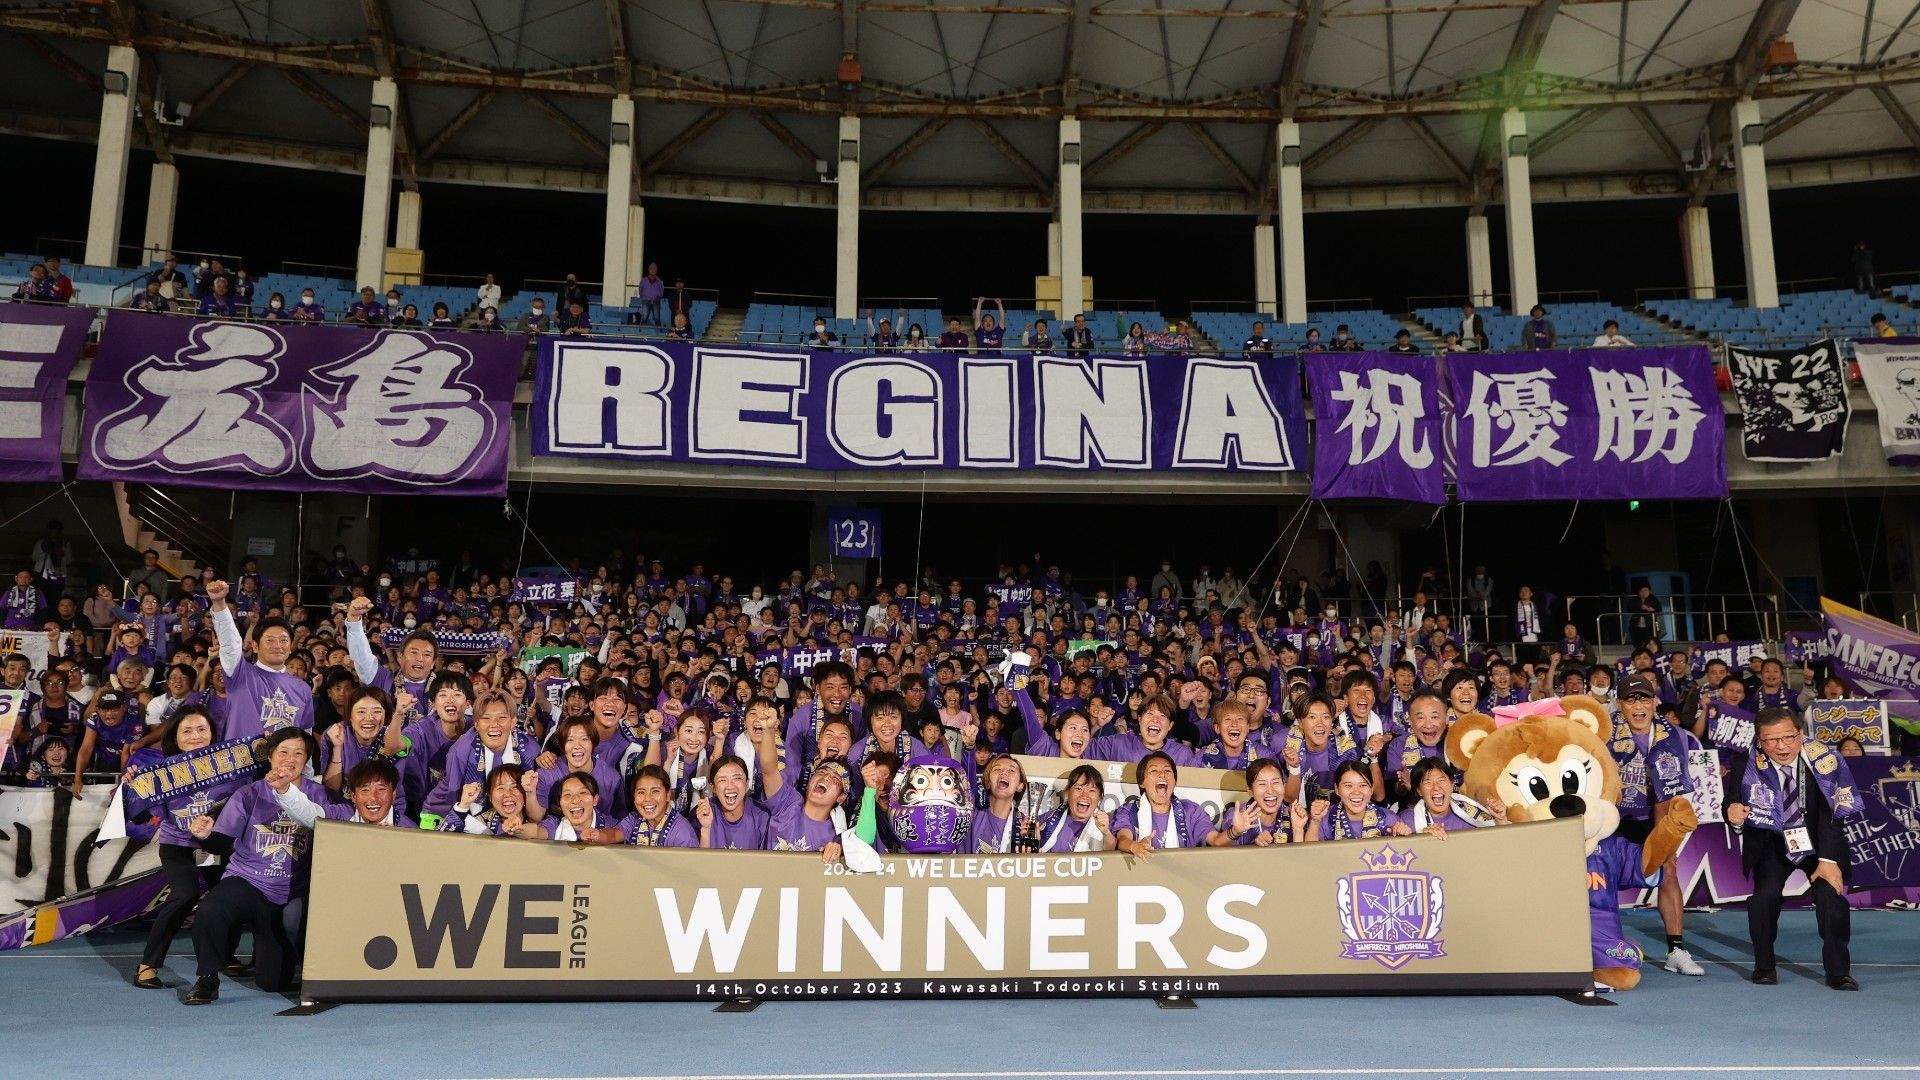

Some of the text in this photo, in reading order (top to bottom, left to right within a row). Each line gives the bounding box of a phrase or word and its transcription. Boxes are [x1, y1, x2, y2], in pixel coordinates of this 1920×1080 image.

[1790, 348, 1831, 379] 22
[93, 322, 497, 486] 広島
[548, 341, 1295, 472] REGINA
[1331, 366, 1707, 469] 祝 優勝
[840, 519, 869, 549] 23
[527, 583, 556, 600] 立花
[1844, 663, 1899, 685] HIROSHIMA
[1813, 705, 1880, 724] レジーナ
[1815, 724, 1883, 742] みんなで
[1748, 812, 1774, 825] Regina
[906, 858, 943, 878] WE
[950, 858, 1045, 878] LEAGUE
[1054, 857, 1103, 877] CUP
[569, 884, 590, 969] LEAGUE
[654, 884, 1268, 974] WINNERS
[1356, 942, 1429, 952] SANFRECCE HIROSHIMA
[695, 979, 1220, 995] 14th October 2023 Kawasaki Todoroki Stadium
